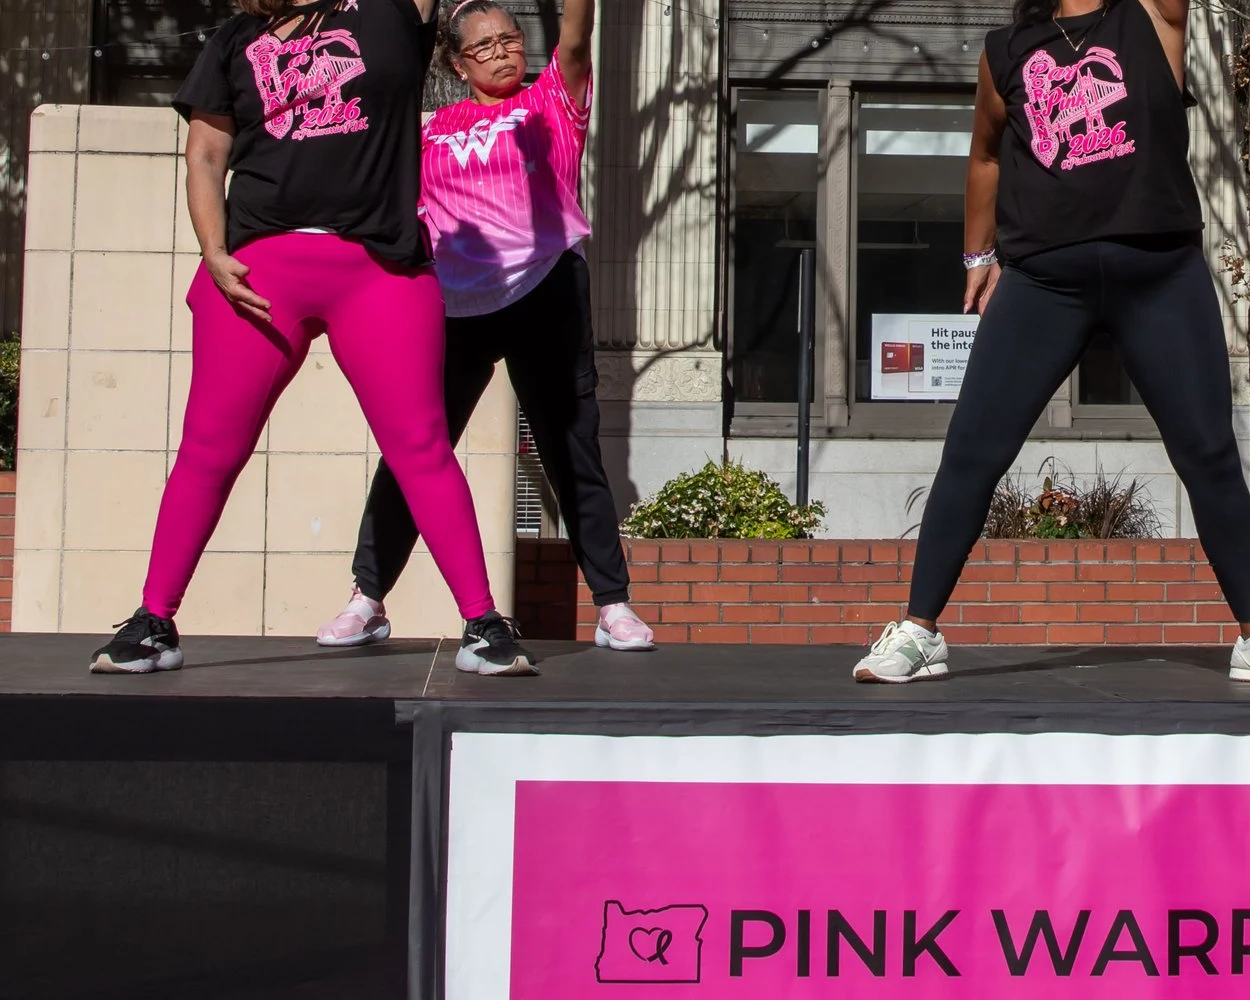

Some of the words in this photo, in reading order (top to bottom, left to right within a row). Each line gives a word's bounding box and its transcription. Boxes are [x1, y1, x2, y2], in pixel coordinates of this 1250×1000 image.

[279, 68, 327, 99] Pink
[301, 97, 361, 129] 2026
[1042, 87, 1087, 117] Pink
[1067, 121, 1126, 158] 2026
[931, 328, 949, 338] Hit
[951, 330, 977, 340] paus
[931, 340, 950, 350] the
[952, 340, 973, 350] inte
[729, 909, 961, 977] PINK
